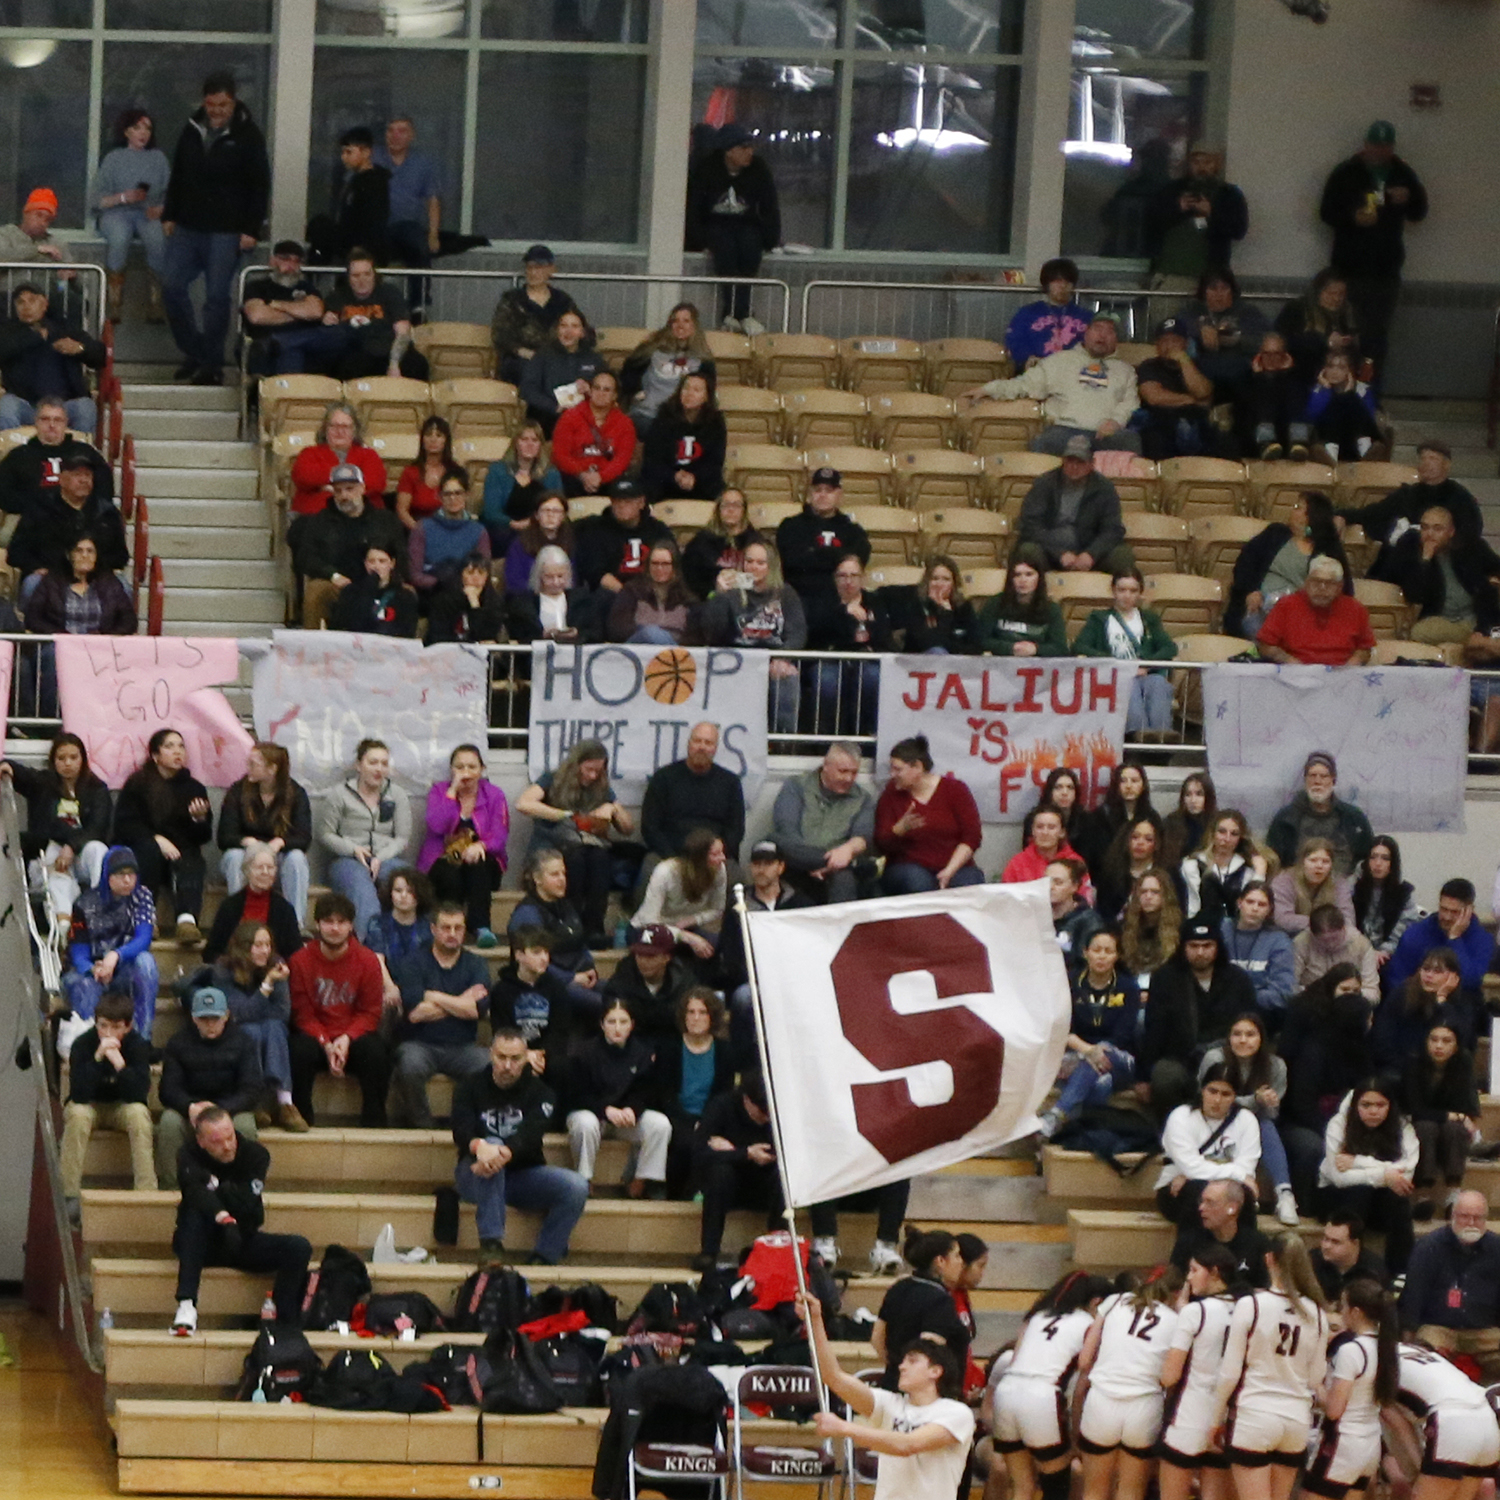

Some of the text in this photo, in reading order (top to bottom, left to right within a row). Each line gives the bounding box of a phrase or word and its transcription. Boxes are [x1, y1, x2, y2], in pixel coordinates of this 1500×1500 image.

[116, 678, 172, 722] GO
[902, 666, 1118, 715] JALIUH
[831, 912, 1005, 1165] S
[1042, 1315, 1062, 1341] 4
[1127, 1311, 1161, 1342] 12
[1275, 1322, 1301, 1357] 21
[751, 1376, 811, 1393] KAYHI
[664, 1456, 717, 1473] KINGS
[770, 1459, 823, 1475] KINGS
